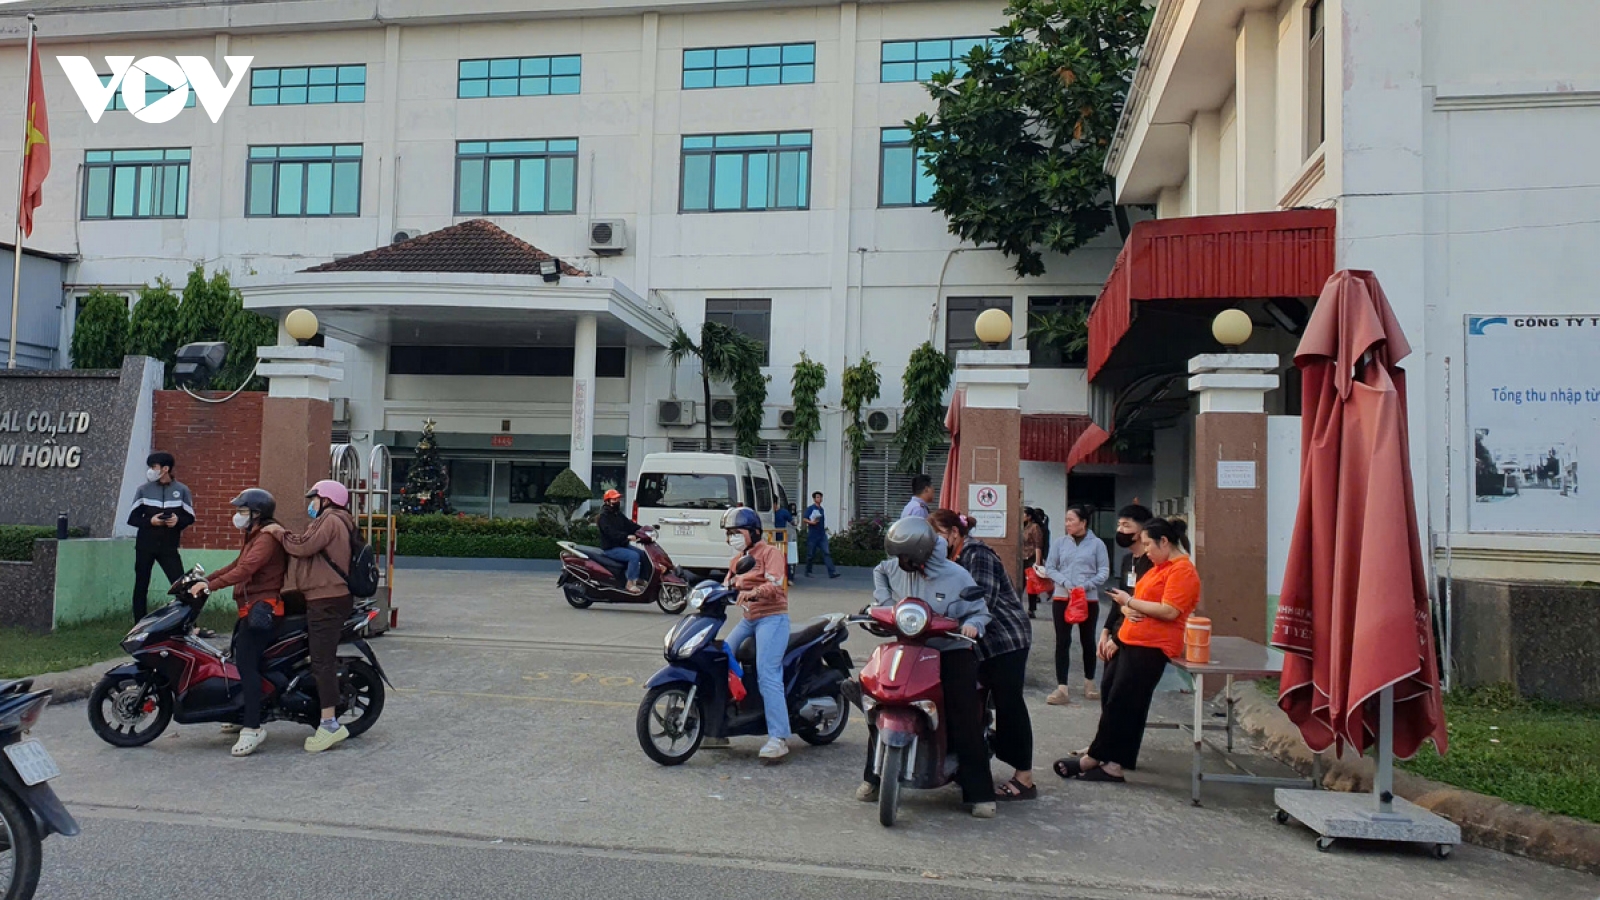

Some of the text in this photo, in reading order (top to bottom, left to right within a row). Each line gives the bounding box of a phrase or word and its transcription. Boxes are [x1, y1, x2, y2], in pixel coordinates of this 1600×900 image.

[1514, 316, 1559, 328] CÔNG
[1566, 317, 1584, 327] TY
[1492, 386, 1522, 405] Tổng
[1525, 388, 1546, 402] thu
[1551, 388, 1582, 405] nhập
[21, 439, 82, 468] HỒNG
